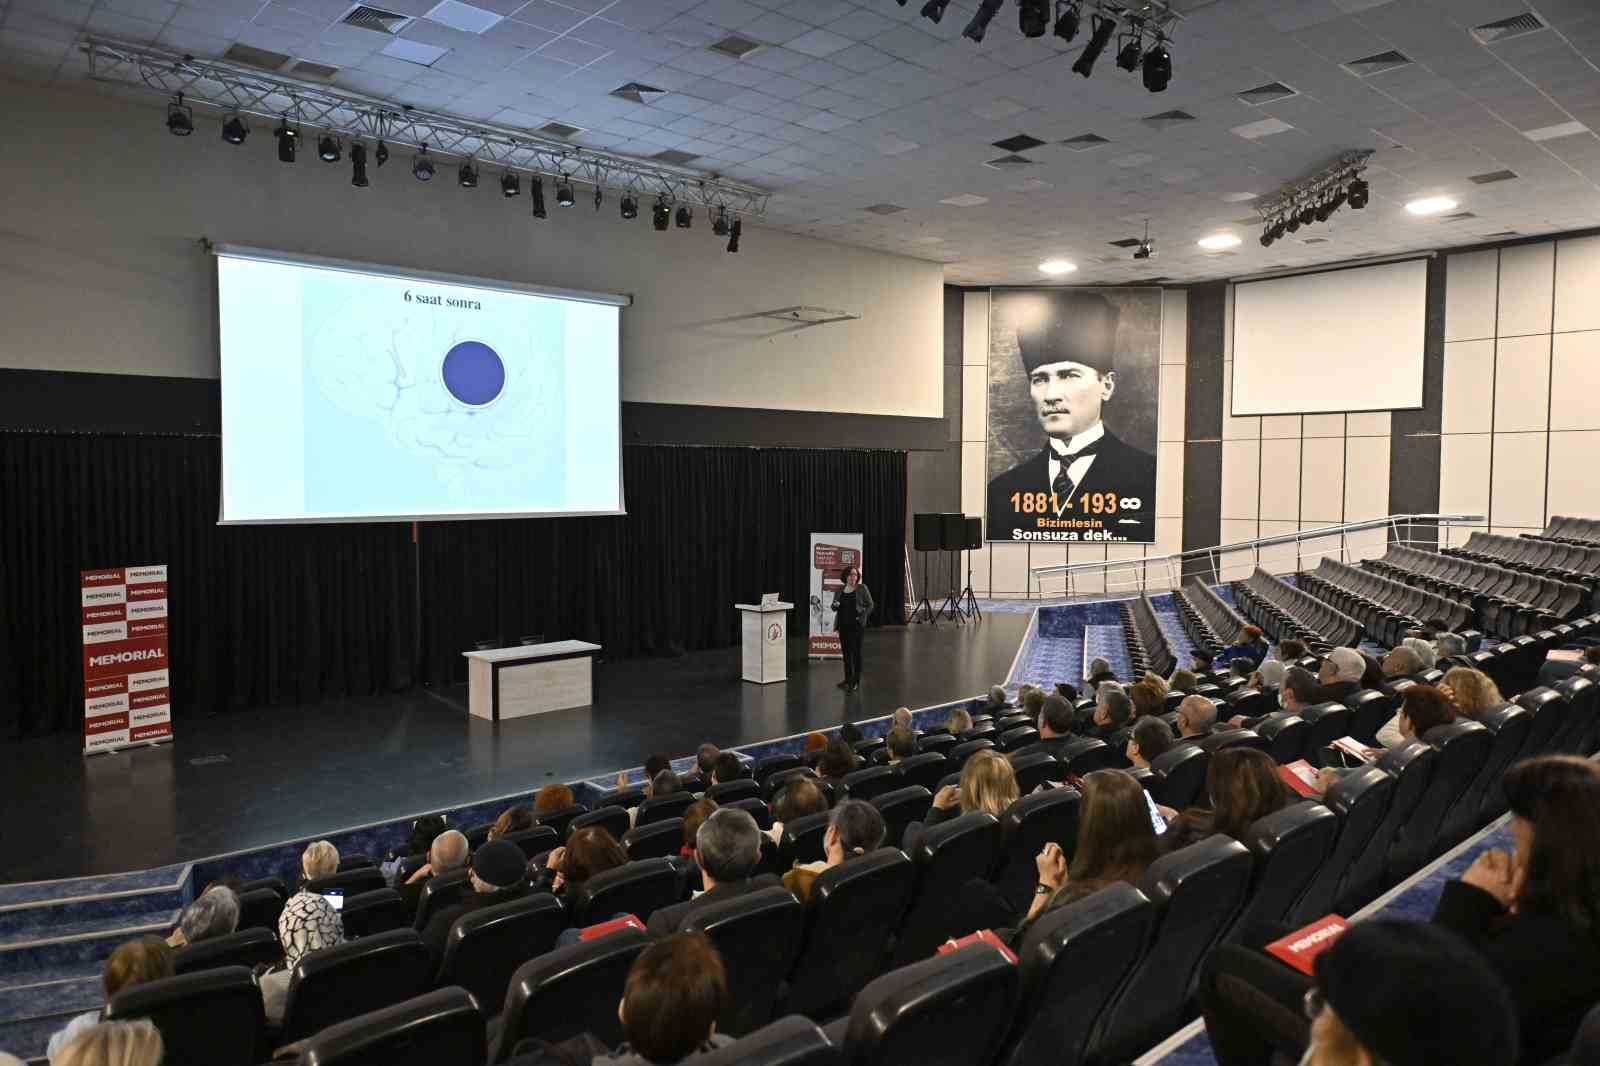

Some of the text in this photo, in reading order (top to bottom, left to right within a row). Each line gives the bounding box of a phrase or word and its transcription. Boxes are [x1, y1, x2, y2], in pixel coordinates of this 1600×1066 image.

[404, 290, 481, 310] 6 saat sonra
[1011, 492, 1059, 513] 1881
[1036, 517, 1103, 528] Bizimlesin
[1012, 528, 1128, 541] Sonsuza dek...
[85, 573, 121, 581] MEMORIAL
[130, 569, 164, 577] MEMORIAL
[86, 591, 121, 600] MEMORIAL
[130, 588, 165, 596] MEMORIAL
[86, 609, 123, 619] MEMORIAL
[131, 605, 165, 614] MEMORIAL
[87, 628, 122, 637] MEMORIAL
[131, 623, 165, 632] MEMORIAL
[89, 647, 165, 668] MEMORIAL
[133, 675, 165, 686] MEMORIAL
[88, 682, 124, 693] MEMORIAL
[133, 693, 166, 703] MEMORIAL
[88, 700, 124, 711] MEMORIAL
[133, 711, 167, 721] MEMORIAL
[89, 718, 124, 729] MEMORIAL
[134, 729, 168, 739] MEMORIAL
[89, 736, 125, 747] MEMORIAL
